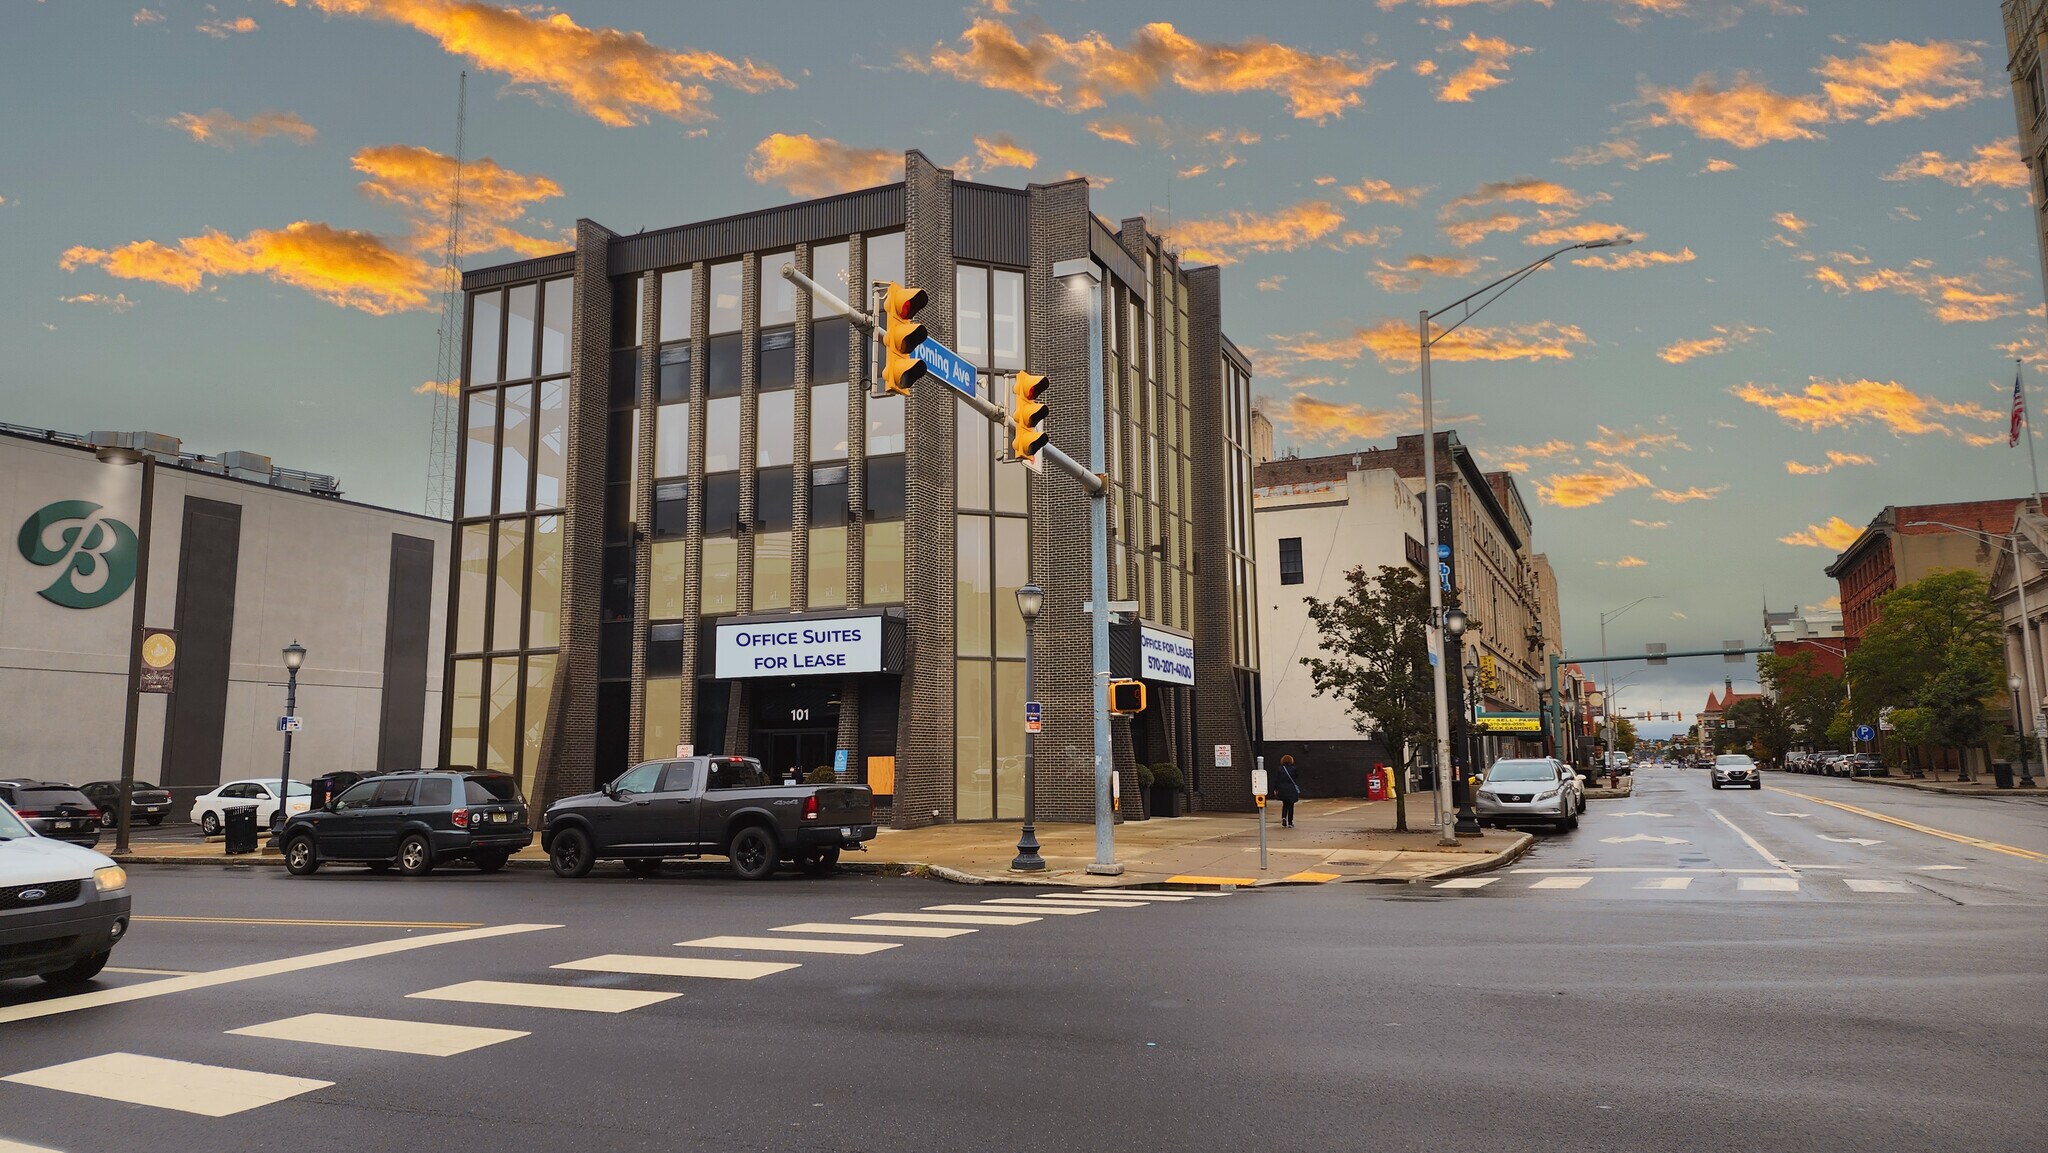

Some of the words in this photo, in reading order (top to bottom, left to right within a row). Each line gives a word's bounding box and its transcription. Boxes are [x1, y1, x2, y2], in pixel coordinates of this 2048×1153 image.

[914, 343, 950, 380] yoming
[952, 361, 971, 387] Ave
[735, 632, 798, 647] OFFICE
[803, 629, 862, 644] SUITES
[1140, 635, 1163, 652] OFFICE
[1162, 642, 1175, 655] FOR
[1174, 643, 1195, 660] LEASE
[754, 656, 788, 670] FOR
[793, 653, 847, 668] LEASE
[1147, 655, 1192, 680] 570-207-4100
[790, 708, 809, 721] 101
[1860, 726, 1869, 736] P
